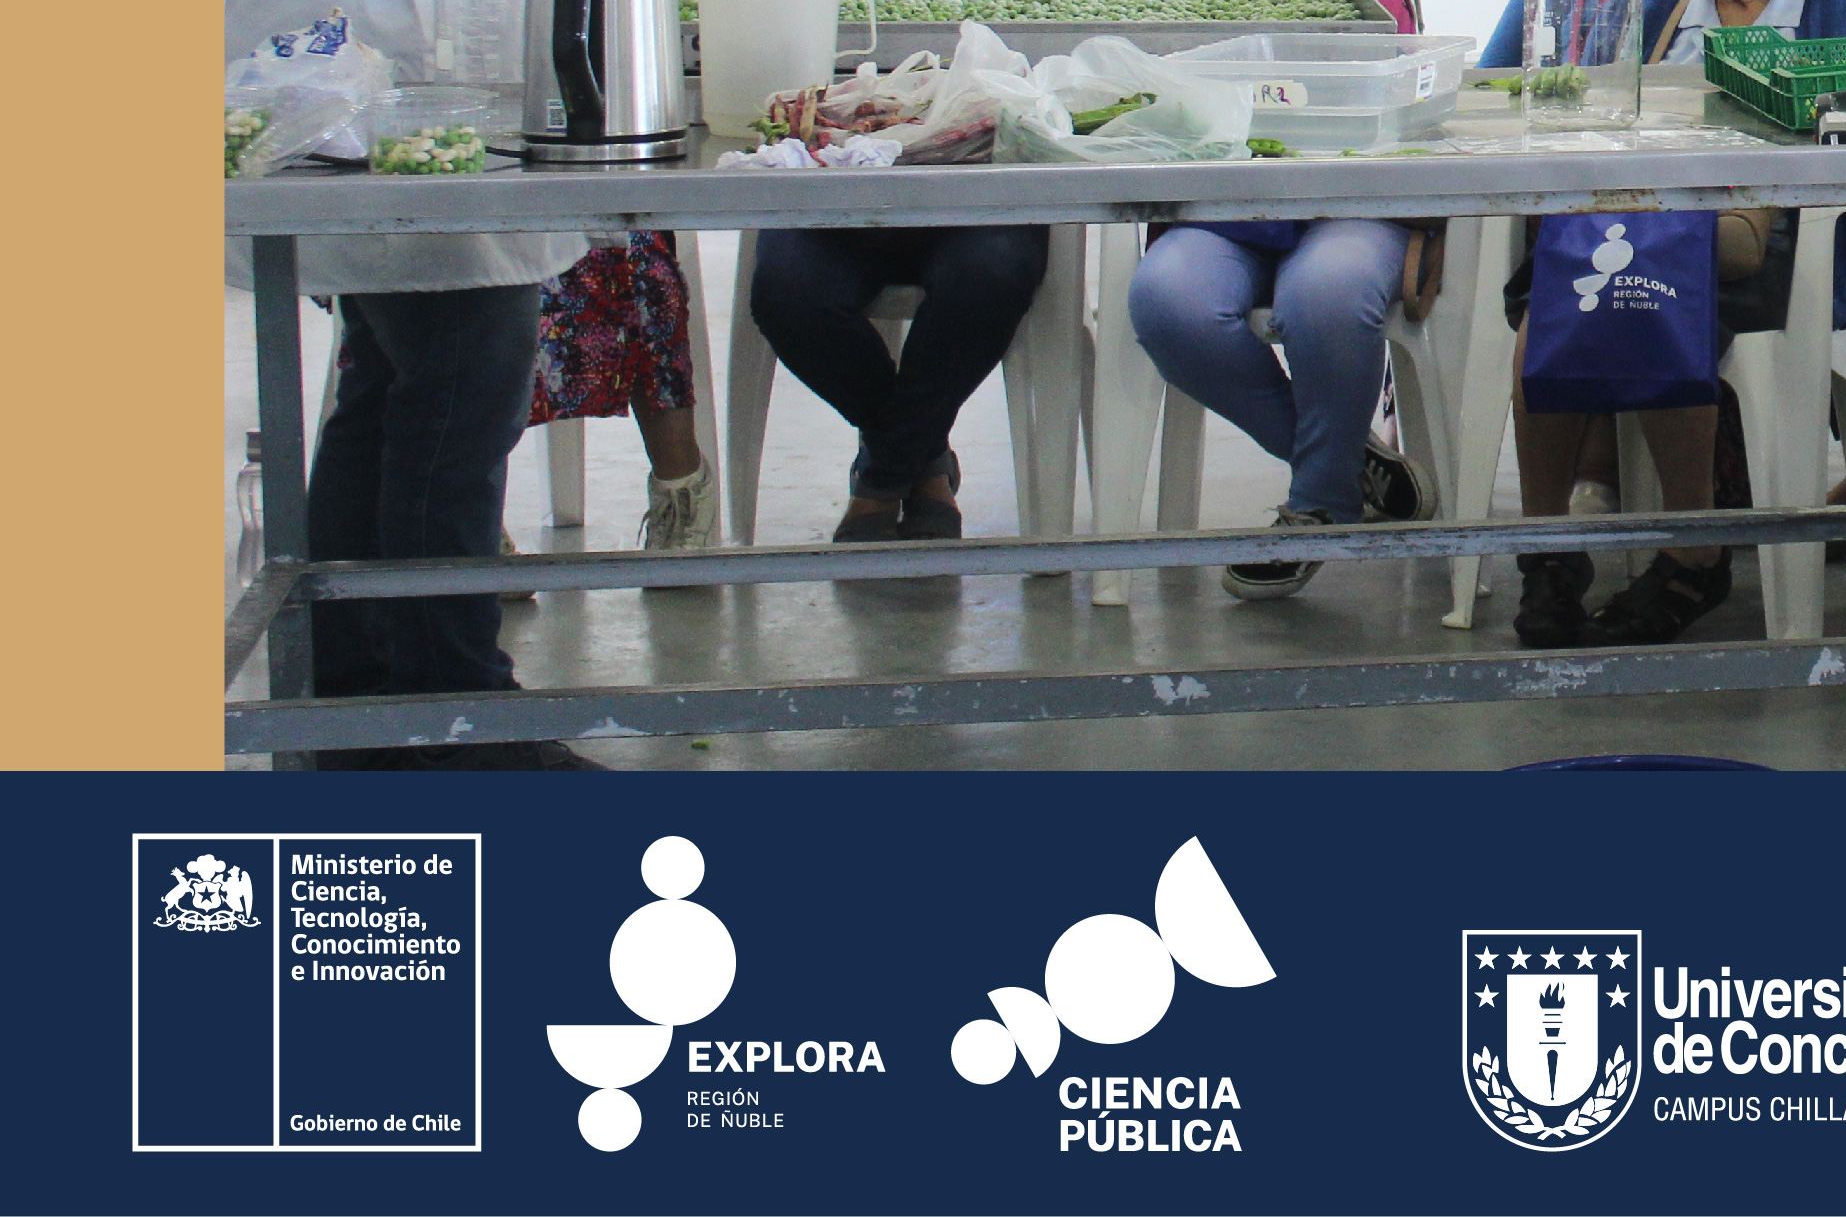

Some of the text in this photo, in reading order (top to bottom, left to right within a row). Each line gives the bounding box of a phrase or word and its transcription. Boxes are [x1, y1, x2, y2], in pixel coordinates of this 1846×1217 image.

[1613, 275, 1677, 299] EXPLORA
[1613, 289, 1649, 300] REGIÓN
[1613, 301, 1625, 310] DE
